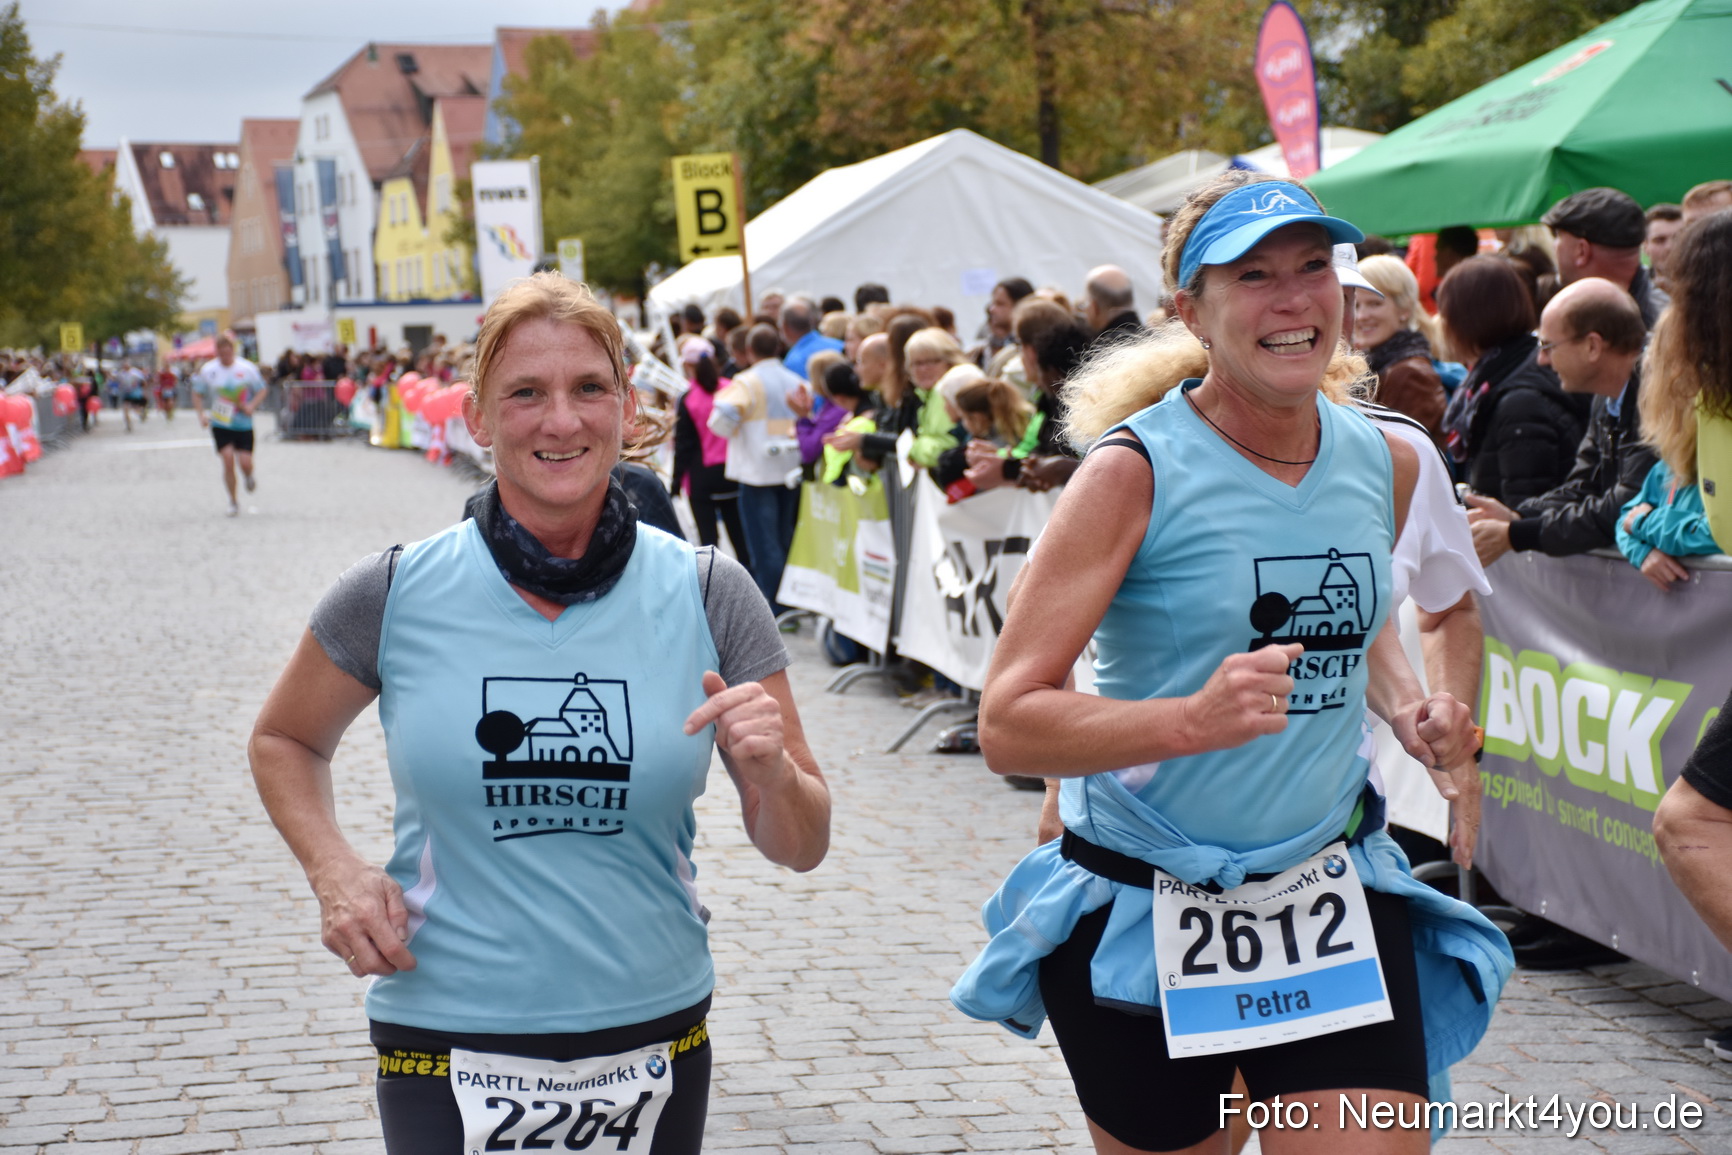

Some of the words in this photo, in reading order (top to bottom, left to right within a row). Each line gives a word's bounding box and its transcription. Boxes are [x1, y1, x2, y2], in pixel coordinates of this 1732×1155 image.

[694, 188, 727, 236] B
[1287, 654, 1361, 681] RSCH
[1484, 651, 1677, 796] BOCK
[483, 784, 630, 811] HIRSCH
[1479, 770, 1543, 812] nspired
[1557, 798, 1600, 840] smart
[1179, 892, 1355, 976] 2612
[1168, 974, 1177, 987] C
[1235, 989, 1312, 1021] Petra
[378, 1055, 450, 1077] queez
[457, 1070, 531, 1092] PARTL
[536, 1064, 639, 1093] Neumarkt
[483, 1090, 653, 1152] 2264
